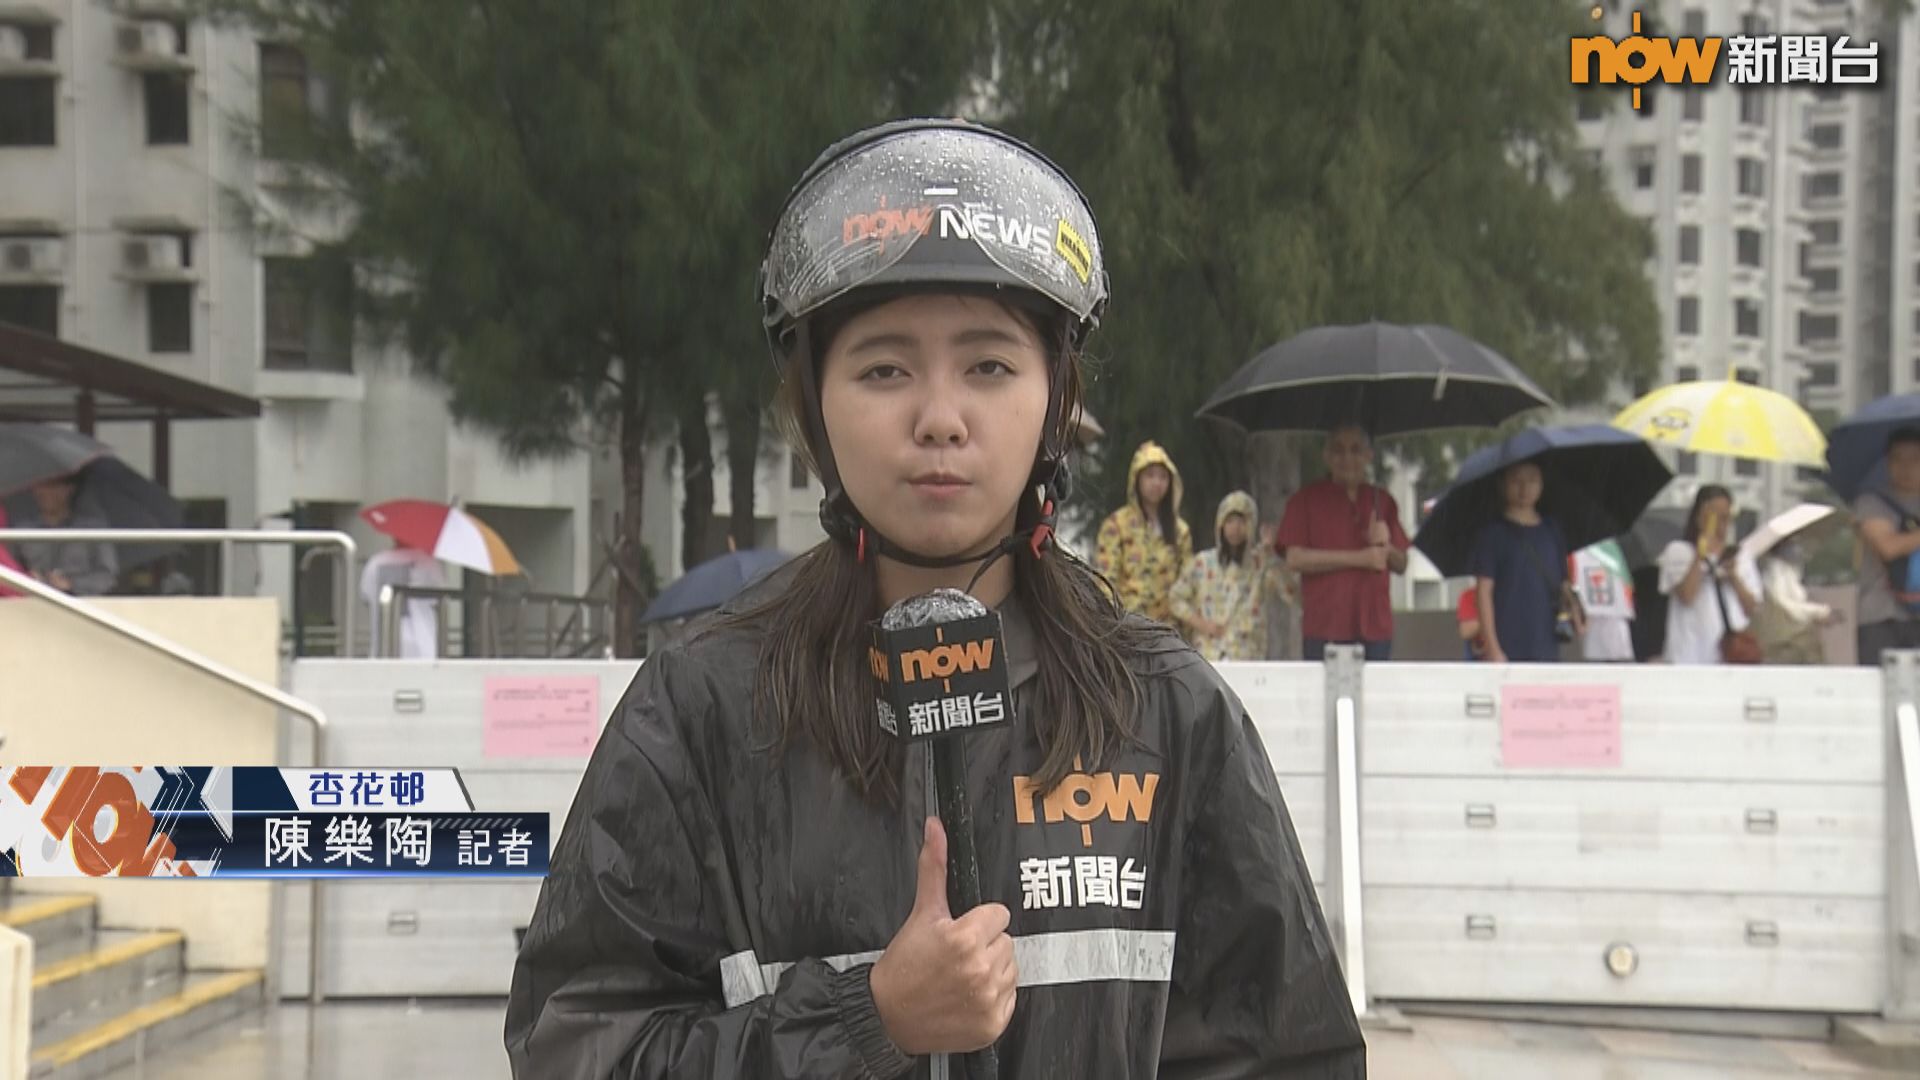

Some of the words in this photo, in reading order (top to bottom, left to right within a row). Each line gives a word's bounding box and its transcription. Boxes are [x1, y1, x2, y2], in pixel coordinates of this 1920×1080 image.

[940, 207, 1052, 256] NEWS
[908, 692, 1004, 736] 新聞台
[1020, 856, 1147, 909] 新聞台
